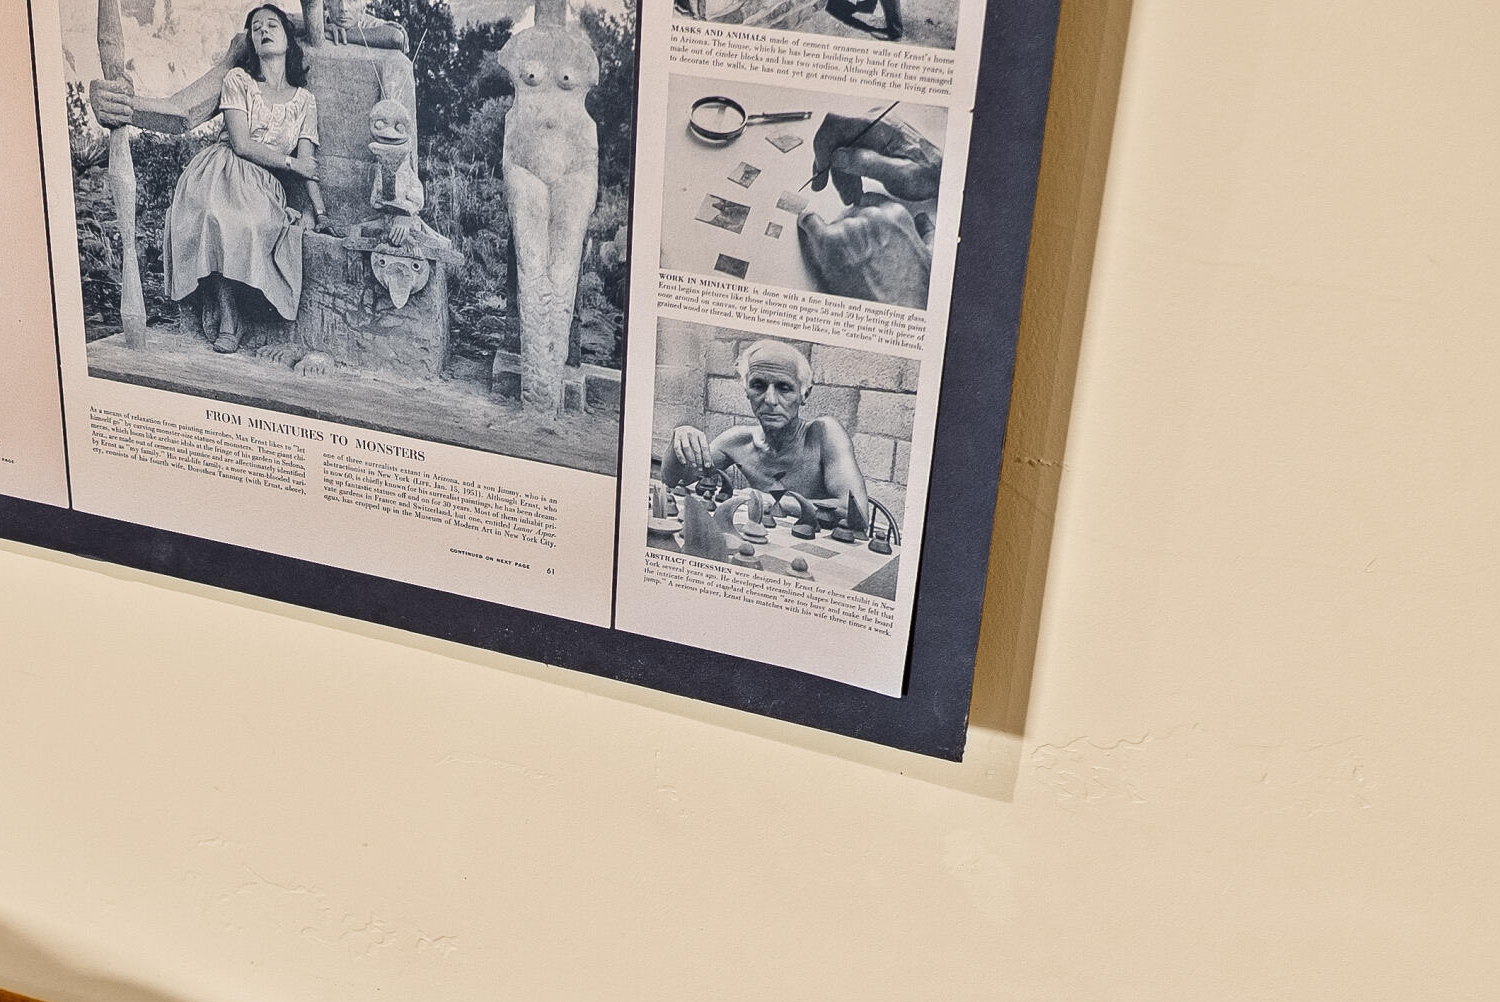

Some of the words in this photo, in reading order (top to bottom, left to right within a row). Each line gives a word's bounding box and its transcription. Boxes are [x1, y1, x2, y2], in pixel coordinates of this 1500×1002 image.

[671, 24, 701, 34] MASKS
[726, 31, 766, 41] ANIMALS
[699, 279, 749, 293] MINIATURE
[206, 409, 241, 425] FROM
[248, 417, 324, 441] MINIATURES
[330, 433, 348, 446] TO
[356, 438, 425, 461] MONSTERS
[342, 496, 353, 504] has
[355, 501, 380, 510] cropped
[382, 506, 391, 514] up
[414, 511, 442, 523] Museum
[453, 519, 479, 531] Modern
[481, 526, 492, 534] Art
[495, 528, 501, 536] in
[504, 530, 519, 539] New
[521, 533, 538, 543] York
[540, 537, 556, 548] City.
[449, 548, 483, 559] CONTINUED
[546, 567, 554, 575] 61
